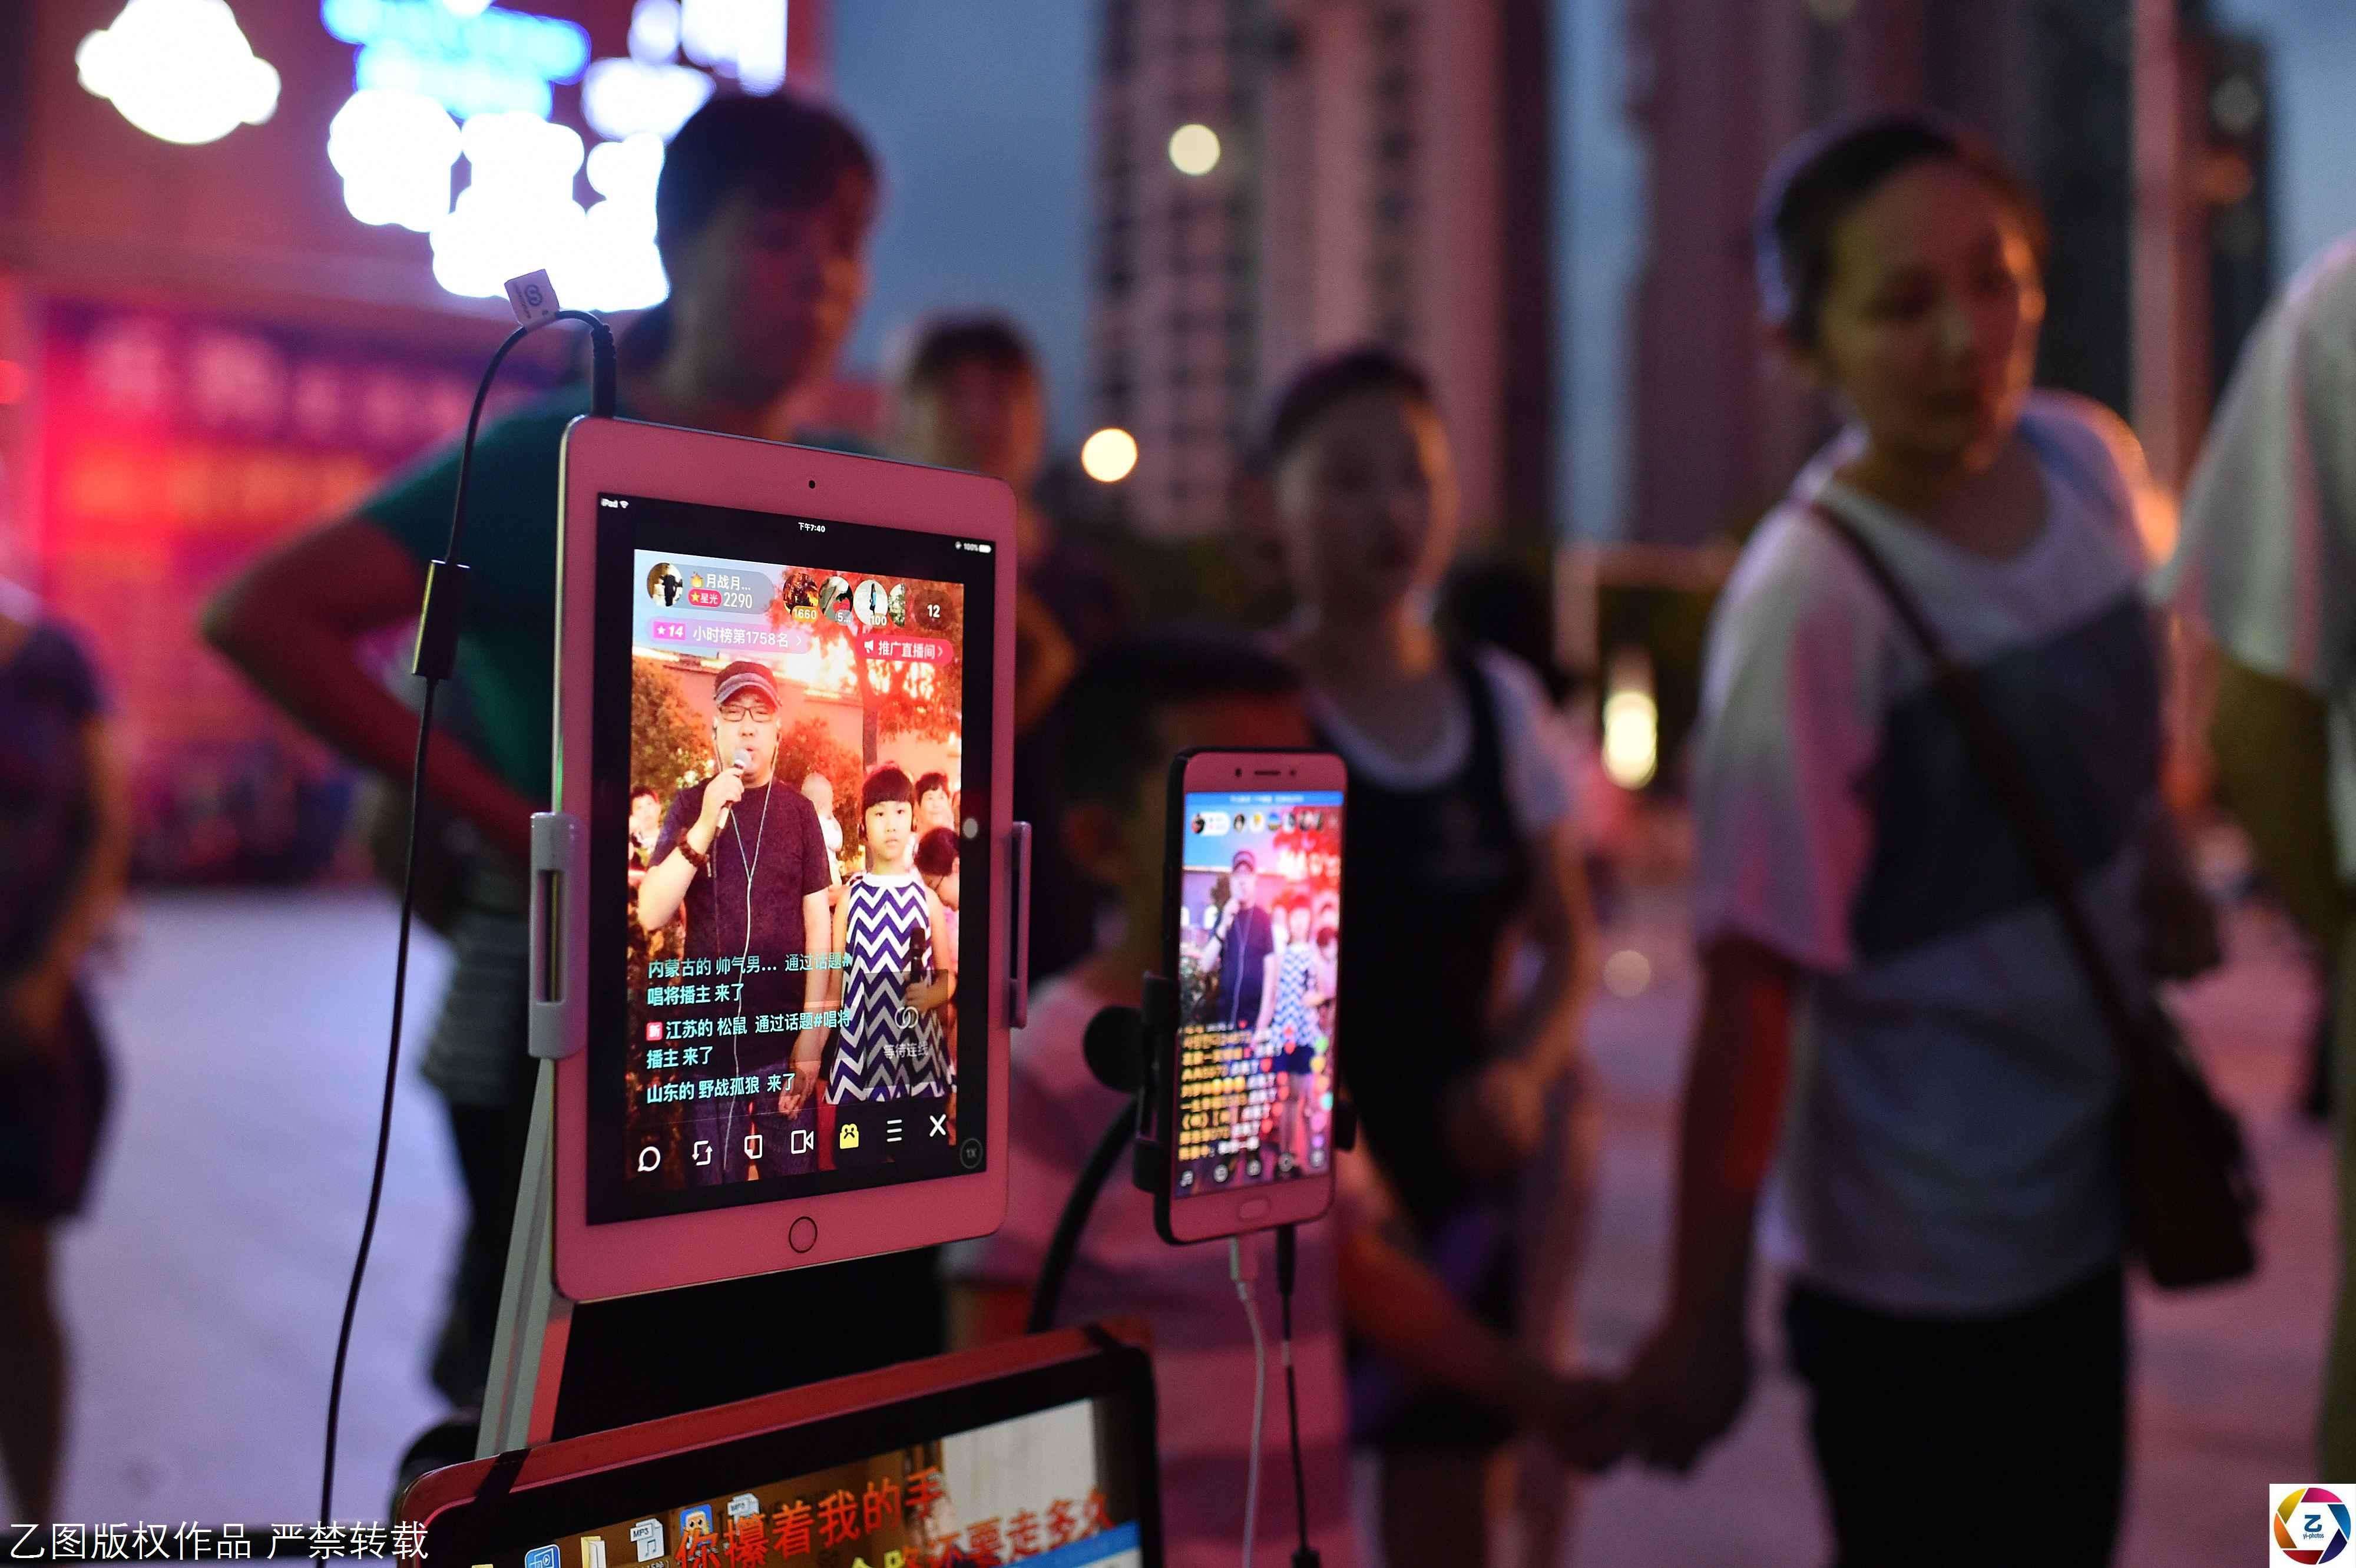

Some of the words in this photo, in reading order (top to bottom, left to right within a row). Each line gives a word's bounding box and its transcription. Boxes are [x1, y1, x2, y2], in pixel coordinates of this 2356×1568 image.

[601, 498, 618, 508] iPad
[798, 522, 826, 532] 下午7:40
[700, 594, 718, 604] 星光
[723, 592, 753, 608] 2290
[794, 608, 817, 620] 1660
[926, 604, 941, 618] 12
[669, 625, 684, 638] 14
[693, 626, 789, 647] 小时榜第1758名
[878, 640, 935, 660] 推广直播间
[648, 958, 711, 979] 内蒙古的
[647, 985, 710, 1006] 唱将播主
[714, 983, 744, 1002] 来了
[666, 1019, 713, 1040] 江苏的
[717, 1017, 747, 1036] 松鼠
[755, 1010, 851, 1034] 通过话题#唱将
[647, 1048, 679, 1069] 播主
[683, 1046, 713, 1066] 来了
[884, 1040, 929, 1060] 等待连线
[647, 1082, 694, 1104] 山东的
[699, 1076, 759, 1099] 野战孤狼
[767, 1073, 796, 1092] 来了
[633, 1527, 649, 1538] MP3
